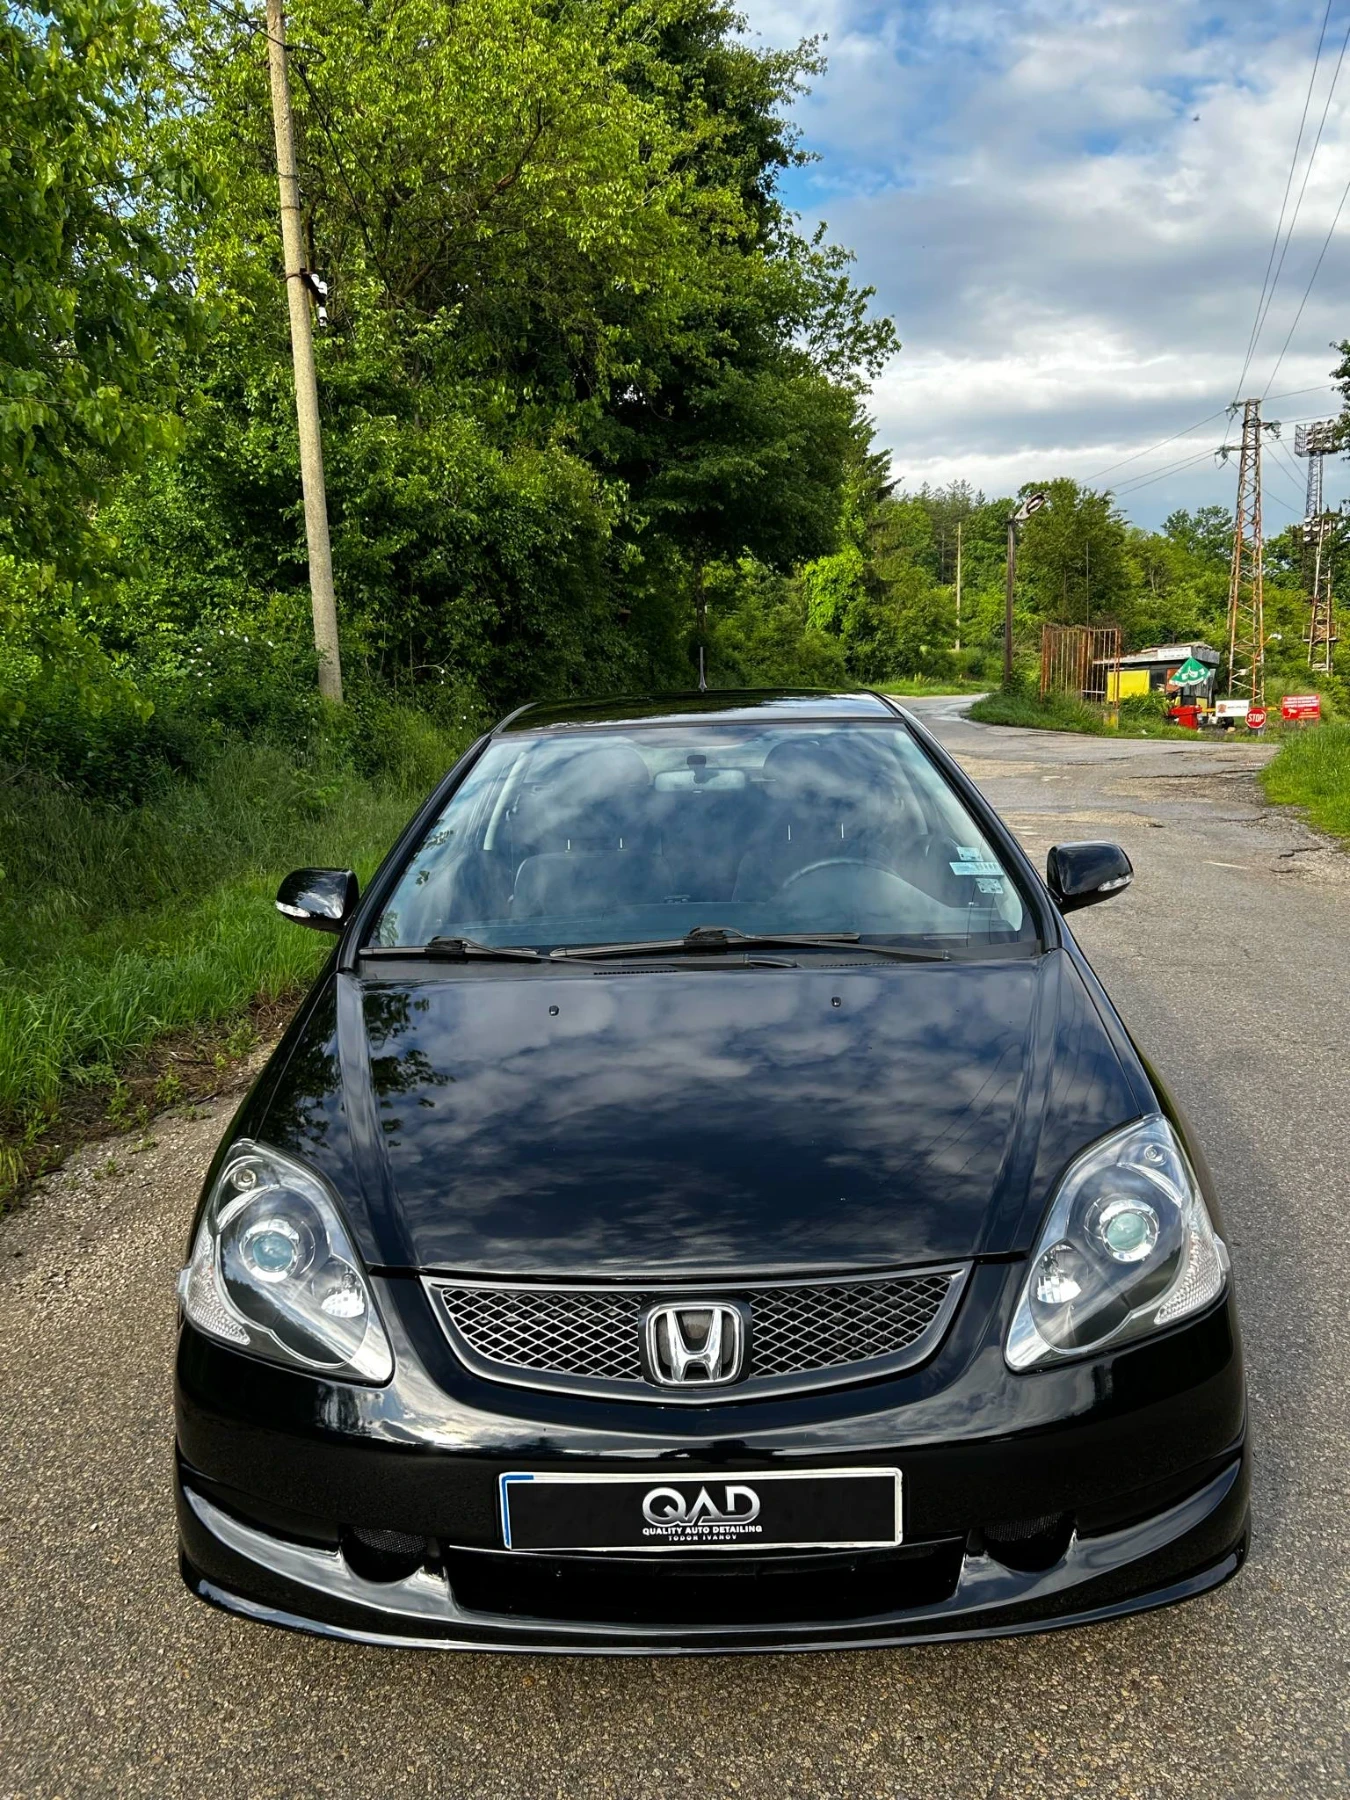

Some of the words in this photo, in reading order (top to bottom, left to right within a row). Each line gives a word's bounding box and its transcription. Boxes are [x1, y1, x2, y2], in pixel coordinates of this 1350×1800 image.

[1247, 713, 1264, 722] STOP
[642, 1485, 760, 1527] QAD
[642, 1527, 683, 1535] QUALITY
[685, 1526, 710, 1534] AUTO
[712, 1525, 763, 1533] DETAILING
